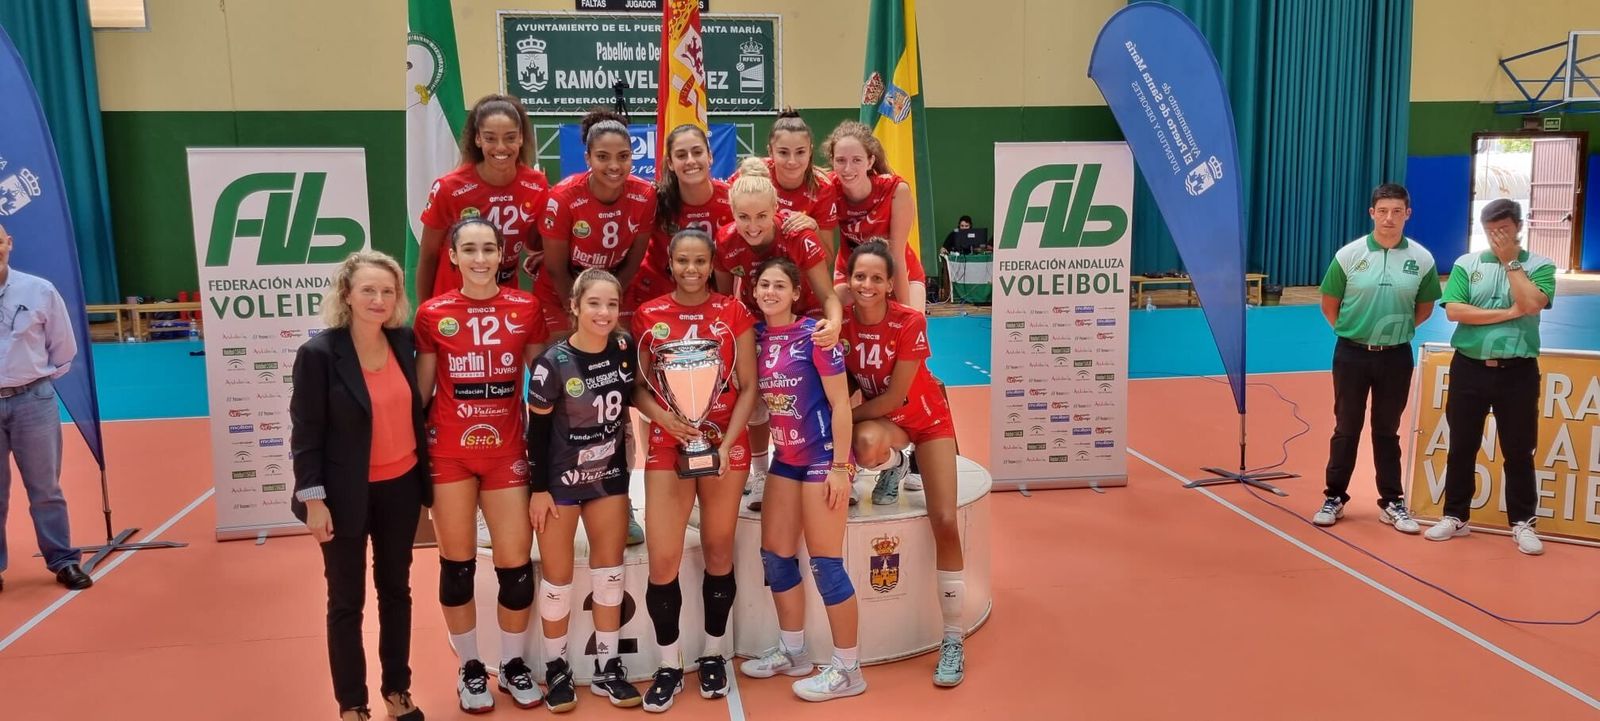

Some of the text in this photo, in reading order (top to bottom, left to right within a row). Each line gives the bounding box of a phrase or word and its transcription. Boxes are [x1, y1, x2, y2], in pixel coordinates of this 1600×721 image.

[581, 0, 657, 9] FALTAS JUGADOR
[516, 24, 599, 32] AYUNTAMIENTO
[602, 24, 616, 32] DE
[618, 24, 631, 32] EL
[634, 24, 662, 33] PUER
[730, 25, 763, 34] MARÍA
[596, 41, 634, 61] Pabellón
[636, 42, 647, 61] de
[555, 66, 619, 89] RAMÓN
[553, 96, 626, 105] FEDERACIÓ
[487, 205, 520, 235] 42
[602, 221, 619, 249] 8
[999, 258, 1125, 272] FEDERACIÓN ANDALUZA
[208, 276, 331, 292] FEDERACIÓN ANDA
[999, 272, 1125, 297] VOLEIBOL
[209, 293, 324, 320] VOLEIB
[466, 316, 501, 346] 12
[448, 351, 485, 372] berlin
[855, 342, 883, 370] 14
[592, 390, 623, 424] 18
